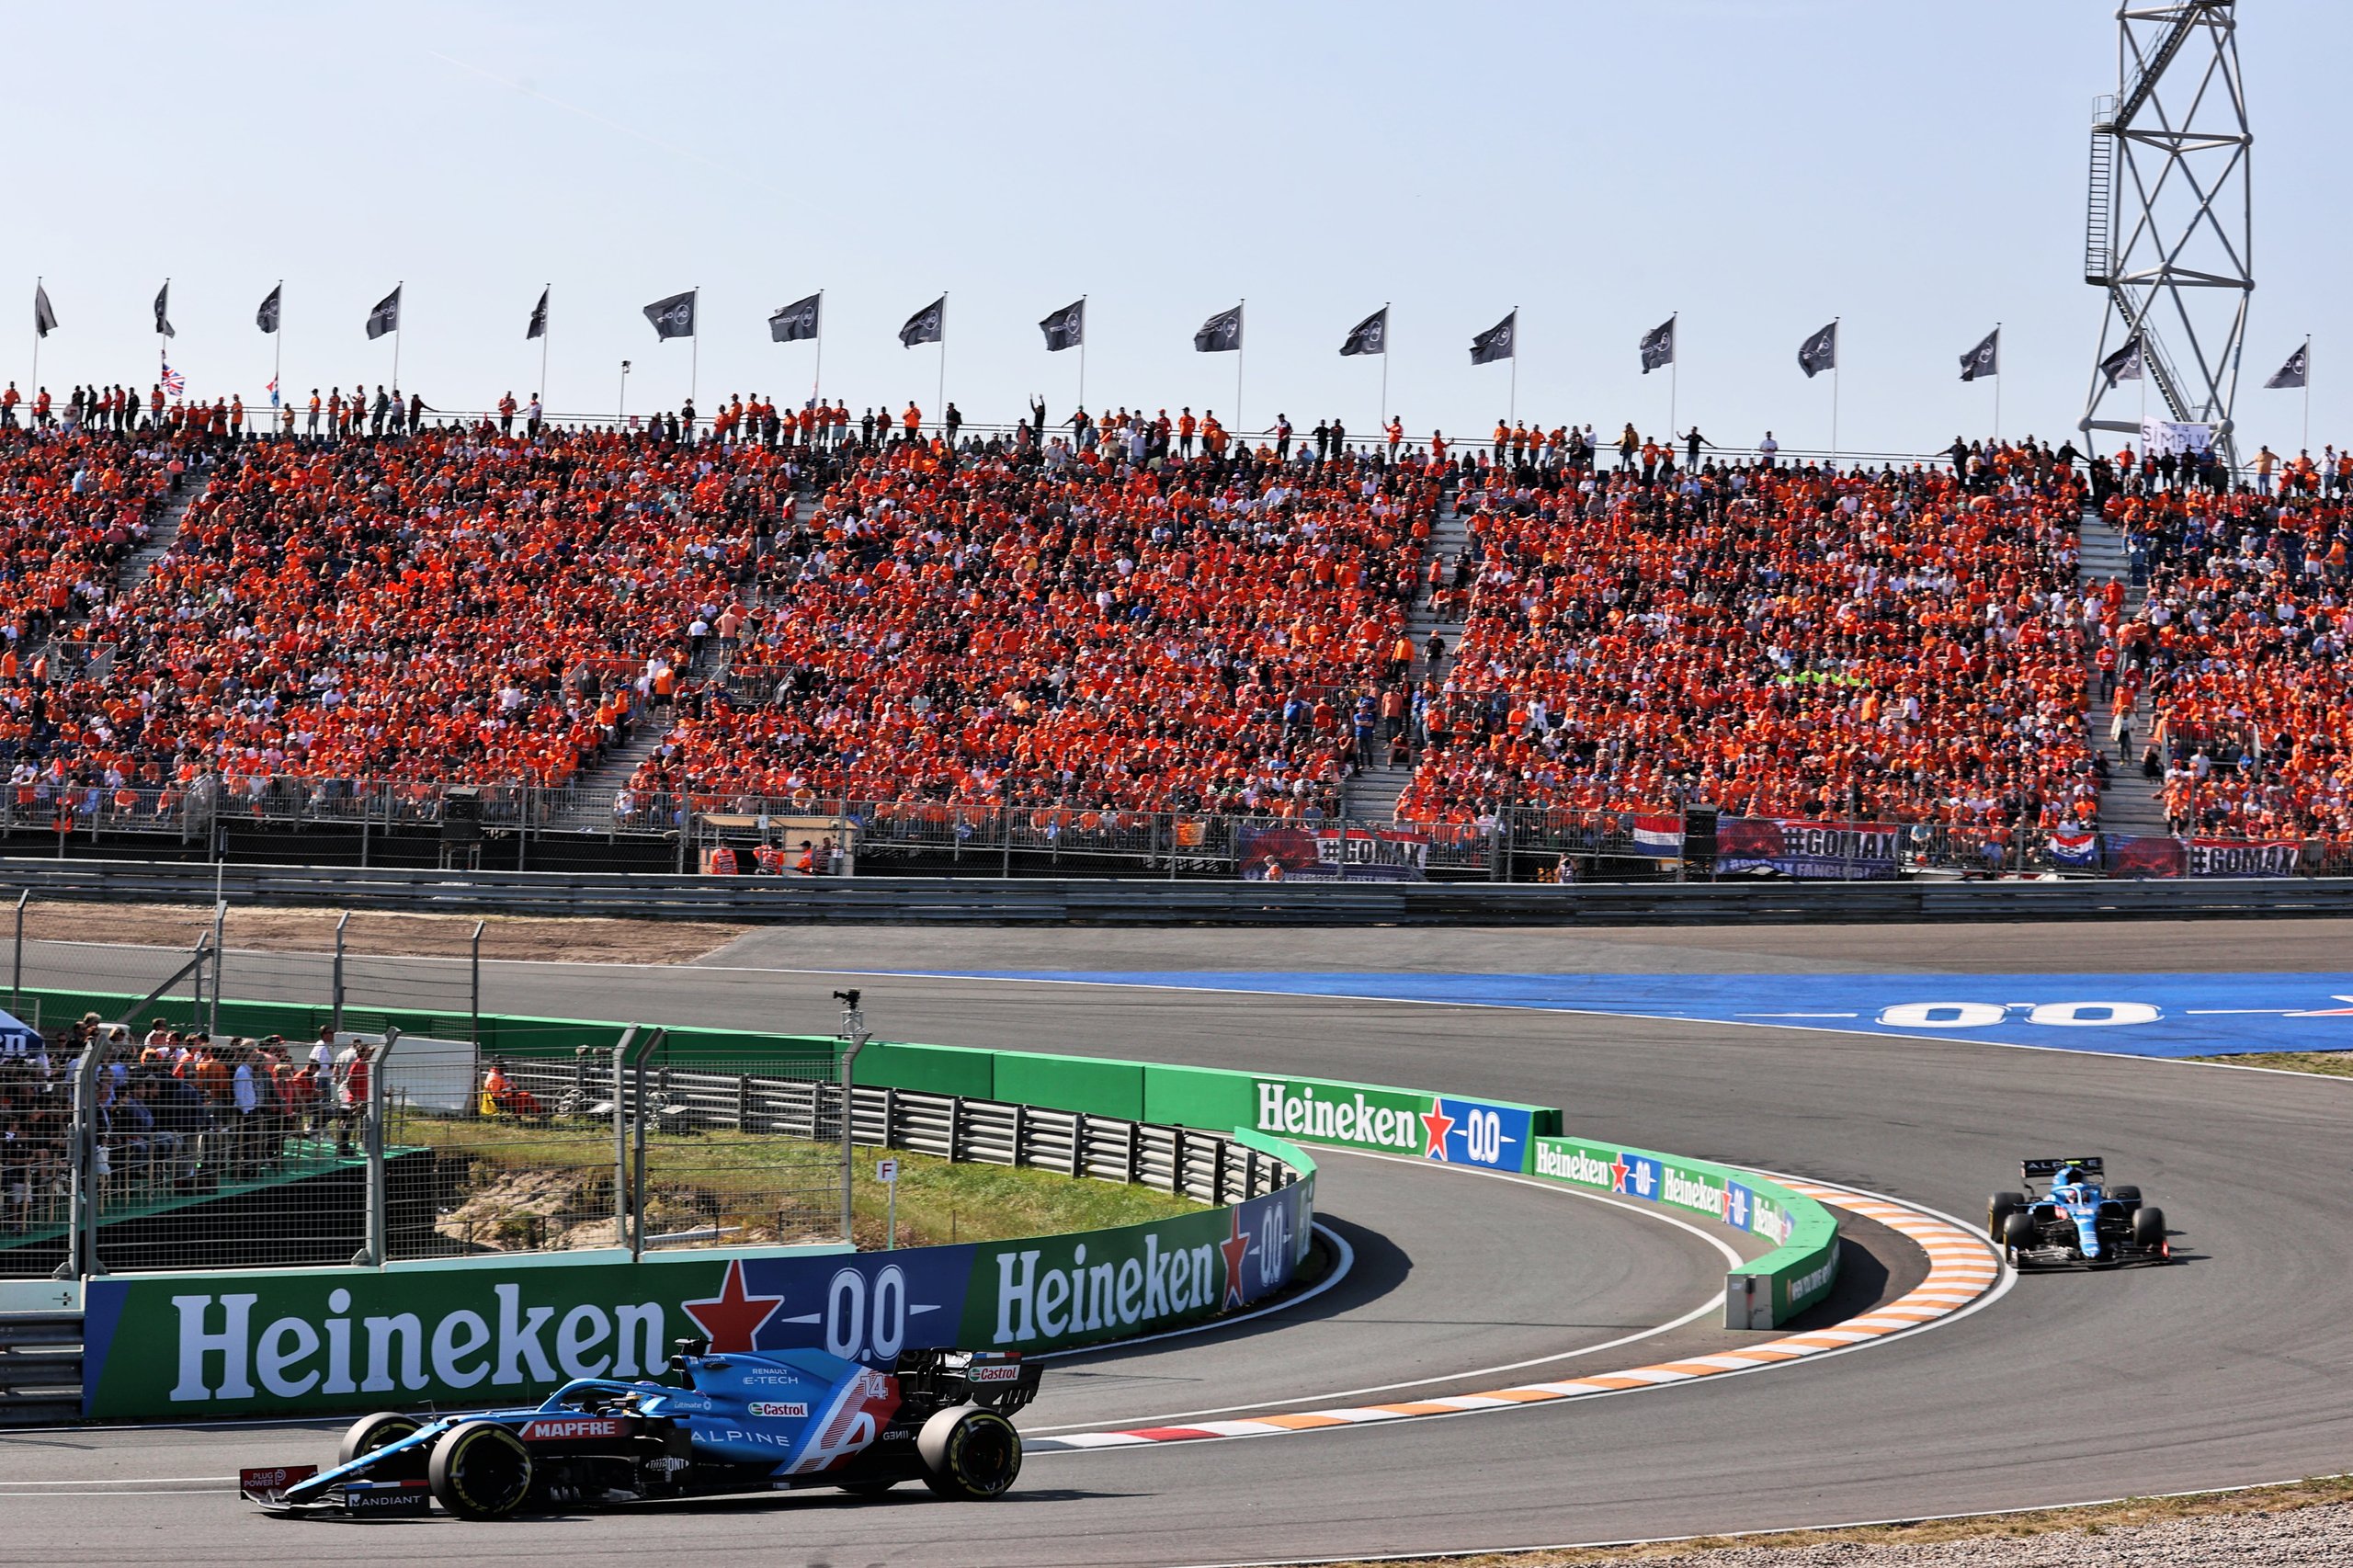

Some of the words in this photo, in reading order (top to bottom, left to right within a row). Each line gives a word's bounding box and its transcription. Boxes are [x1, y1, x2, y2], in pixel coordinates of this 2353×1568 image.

[1257, 1083, 1418, 1149] Heineken
[1468, 1108, 1501, 1165] 0.0
[881, 1163, 892, 1179] F
[1536, 1142, 1609, 1187] Heineken
[1664, 1167, 1722, 1215] Heineken
[993, 1233, 1214, 1344] Heineken
[169, 1282, 671, 1403] Heineken
[826, 1263, 905, 1362] 0.0
[752, 1368, 788, 1376] RENAULT
[980, 1365, 1017, 1381] Castrol
[743, 1376, 799, 1385] E-TECH
[859, 1372, 889, 1400] 14
[764, 1403, 805, 1415] Castrol
[534, 1421, 615, 1437] MAPFRE
[691, 1429, 790, 1448] ALPINE
[244, 1480, 274, 1488] POWER
[253, 1472, 274, 1481] PLUG
[347, 1494, 423, 1507] MANDIANT
